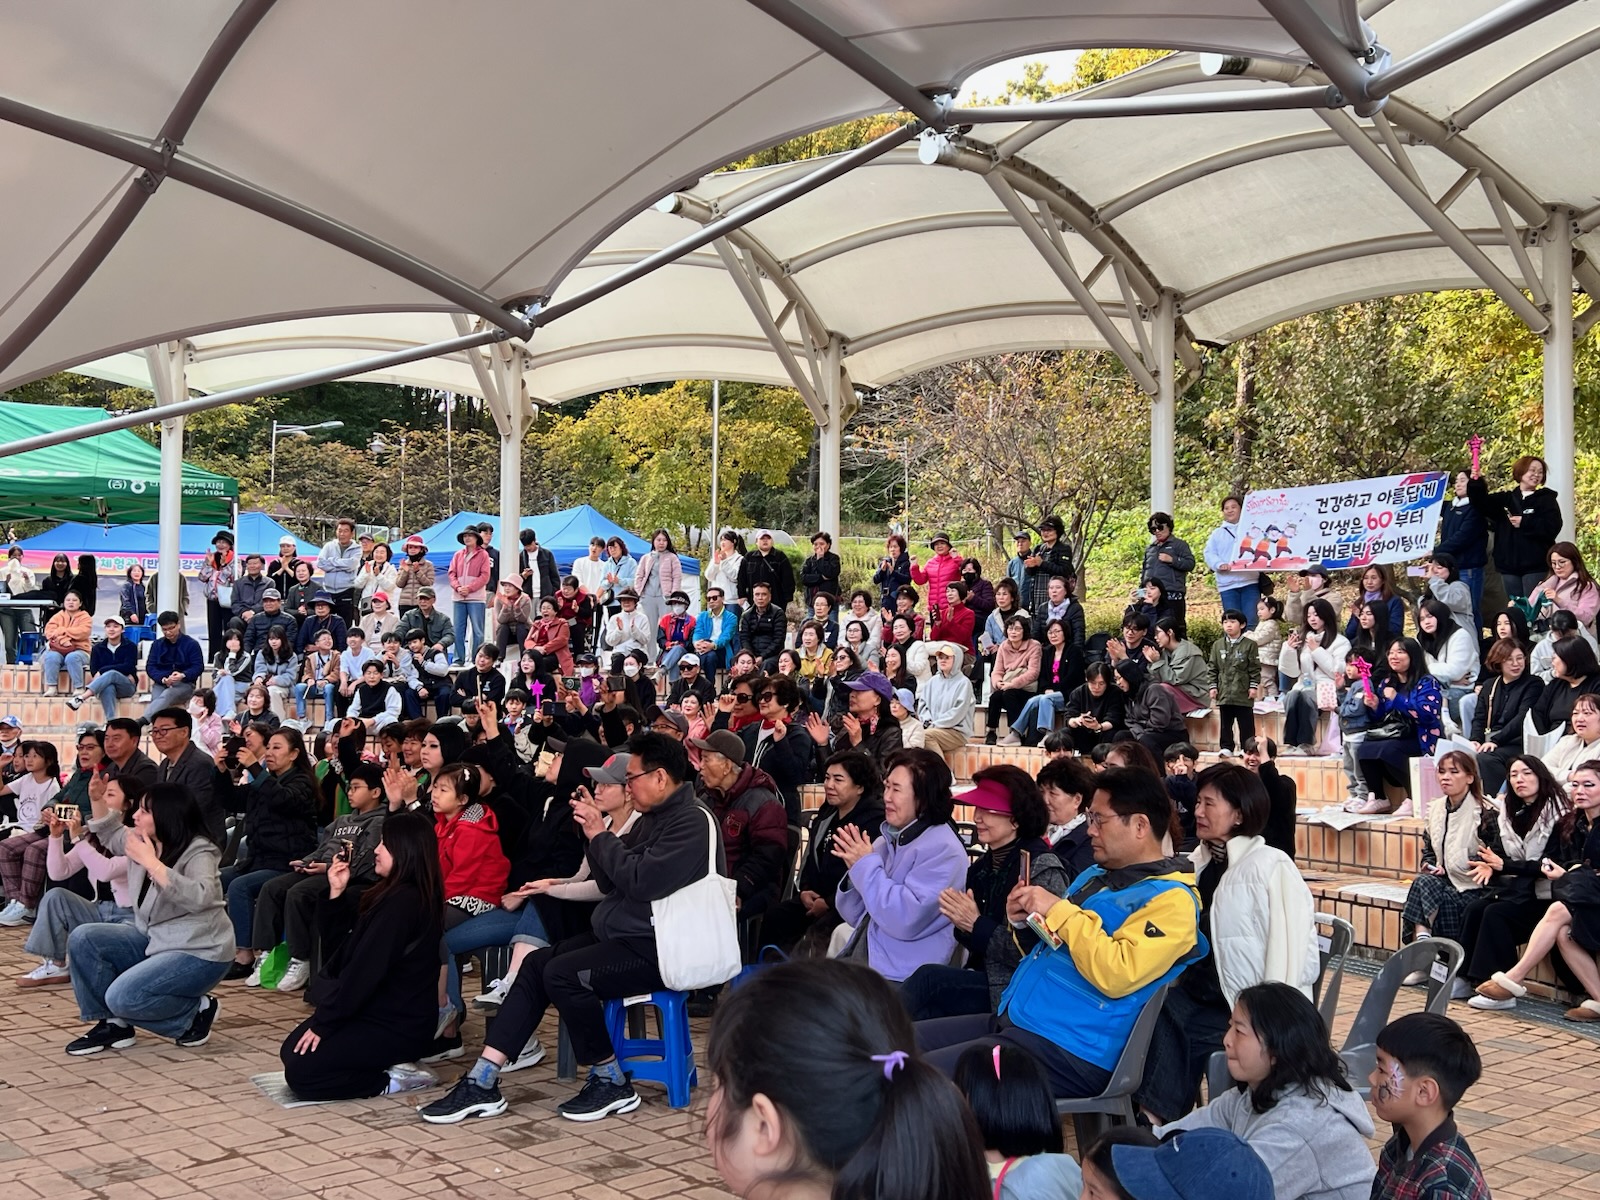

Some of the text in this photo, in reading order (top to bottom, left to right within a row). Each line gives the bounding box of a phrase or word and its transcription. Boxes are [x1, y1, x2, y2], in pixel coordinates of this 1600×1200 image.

[1315, 482, 1437, 514] 건강하고 아름답게
[1319, 518, 1364, 537] 인생은
[1306, 542, 1367, 563] 실버로빅
